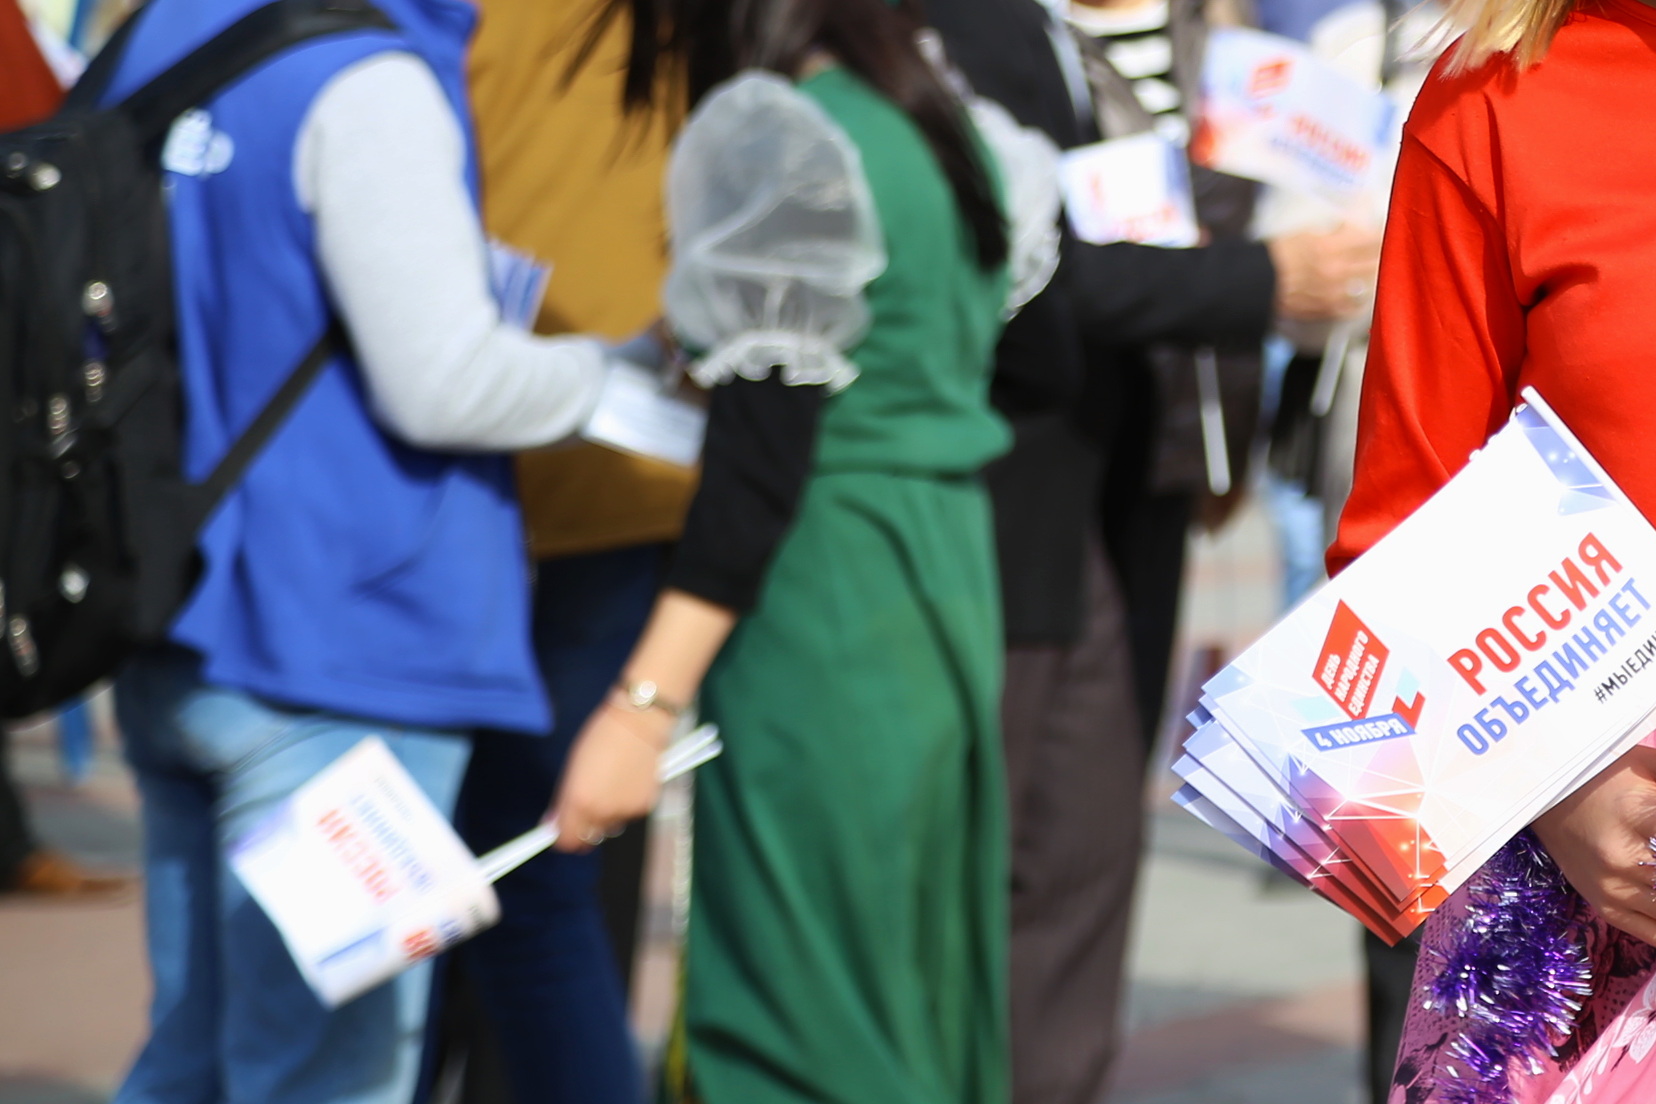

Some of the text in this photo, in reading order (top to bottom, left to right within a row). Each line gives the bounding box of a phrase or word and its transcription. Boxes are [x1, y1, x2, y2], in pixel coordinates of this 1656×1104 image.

[1447, 532, 1623, 695] РОССИЯ
[1320, 654, 1341, 690] ДЕНЬ
[1334, 630, 1369, 702] НАРОДНОГО
[1348, 654, 1380, 716] ЕДИНСТВА
[1456, 577, 1651, 755] ОБЪЕДИНЯЕТ
[1314, 718, 1408, 747] 4 НОЯБРЯ
